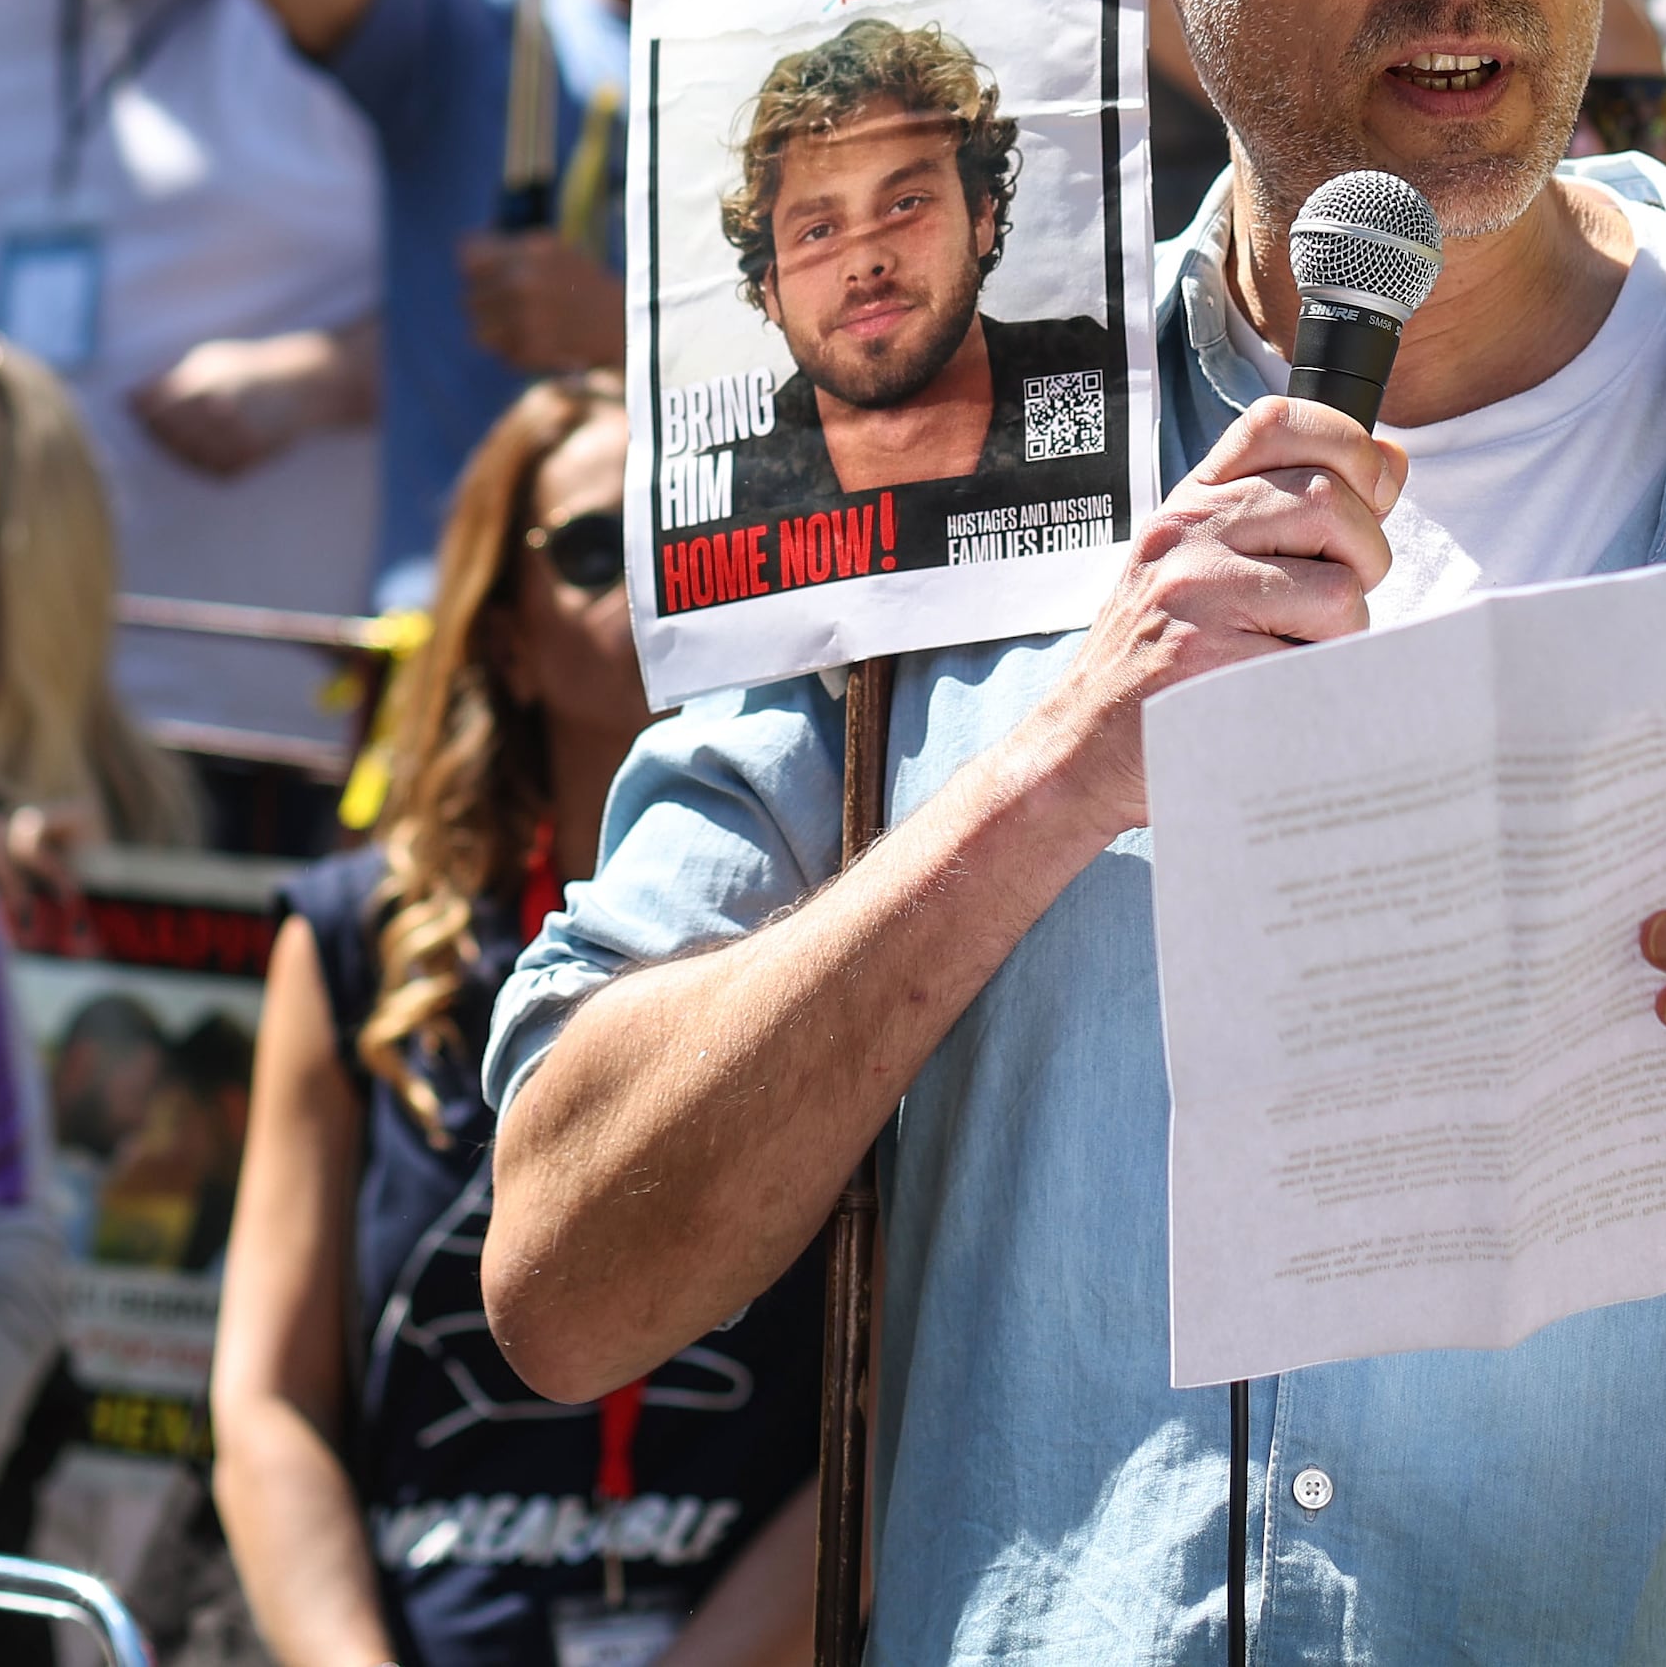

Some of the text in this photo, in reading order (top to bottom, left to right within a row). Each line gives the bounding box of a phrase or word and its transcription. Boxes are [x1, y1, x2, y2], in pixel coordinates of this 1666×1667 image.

[1308, 303, 1361, 323] SHURE
[1368, 314, 1393, 331] SM58
[659, 365, 776, 456] BRING
[659, 448, 734, 532] HIM
[946, 493, 1113, 538] HOSTAGES AND MISSING
[663, 490, 898, 614] HOME NOW!
[948, 517, 1114, 567] FAMILIES FORUM
